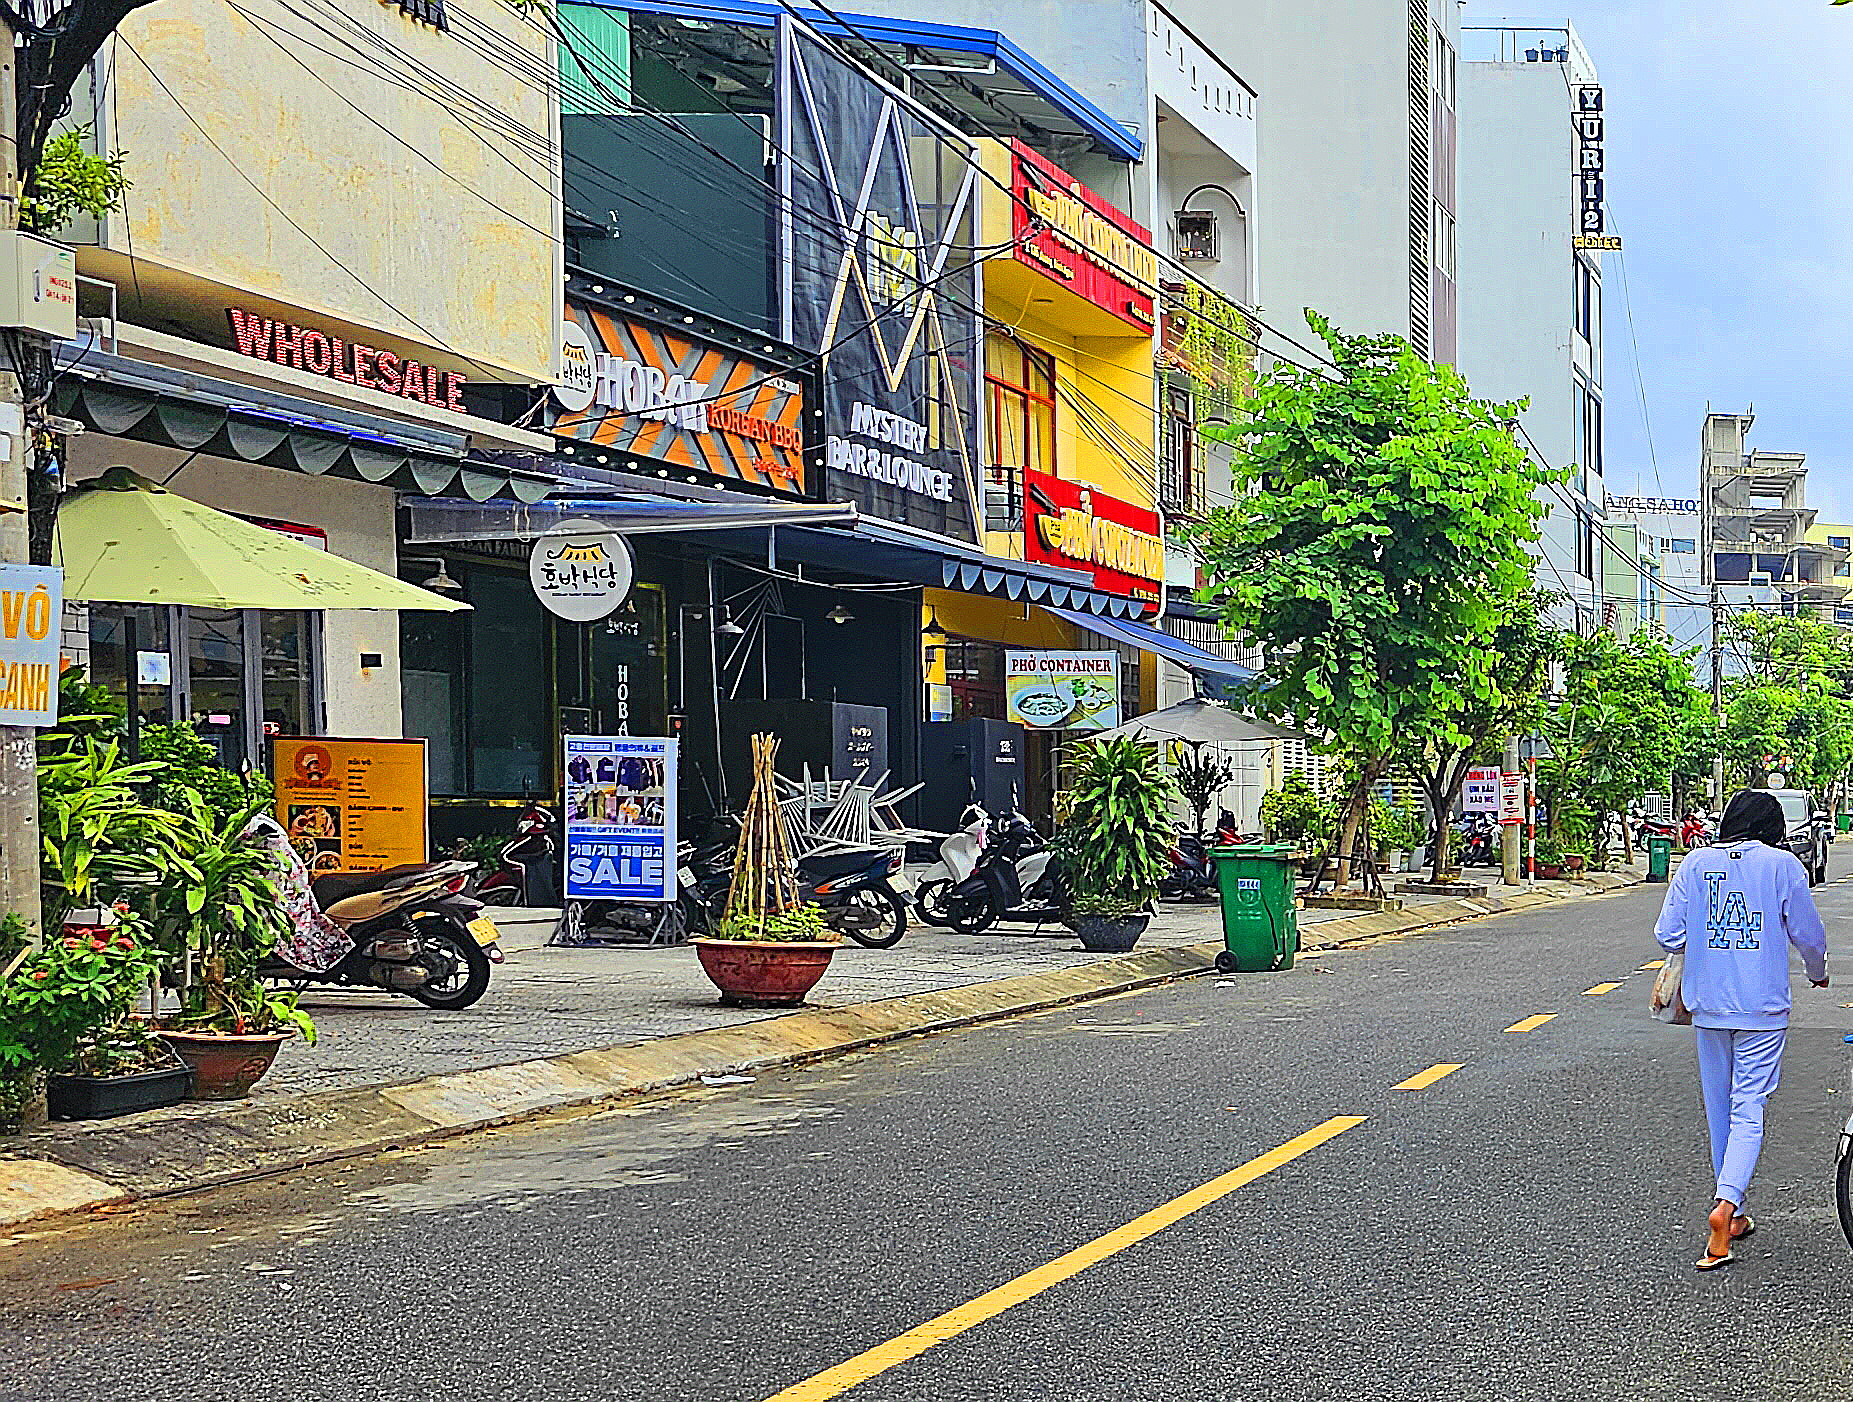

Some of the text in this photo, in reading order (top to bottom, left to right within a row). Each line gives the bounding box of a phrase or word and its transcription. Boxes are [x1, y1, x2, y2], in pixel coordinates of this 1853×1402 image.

[1573, 236, 1622, 249] HOTEL
[224, 306, 470, 415] WHOLESALE
[595, 351, 715, 434] HOBAK
[706, 403, 803, 456] KOREAN BBQ
[851, 401, 928, 454] MYSTERY
[826, 435, 954, 503] BAR&LOUNGE
[540, 562, 618, 590] 호박식당
[1011, 654, 1112, 673] PHỞ CONTAINER
[569, 857, 664, 886] SALE
[1703, 871, 1762, 950] LA
